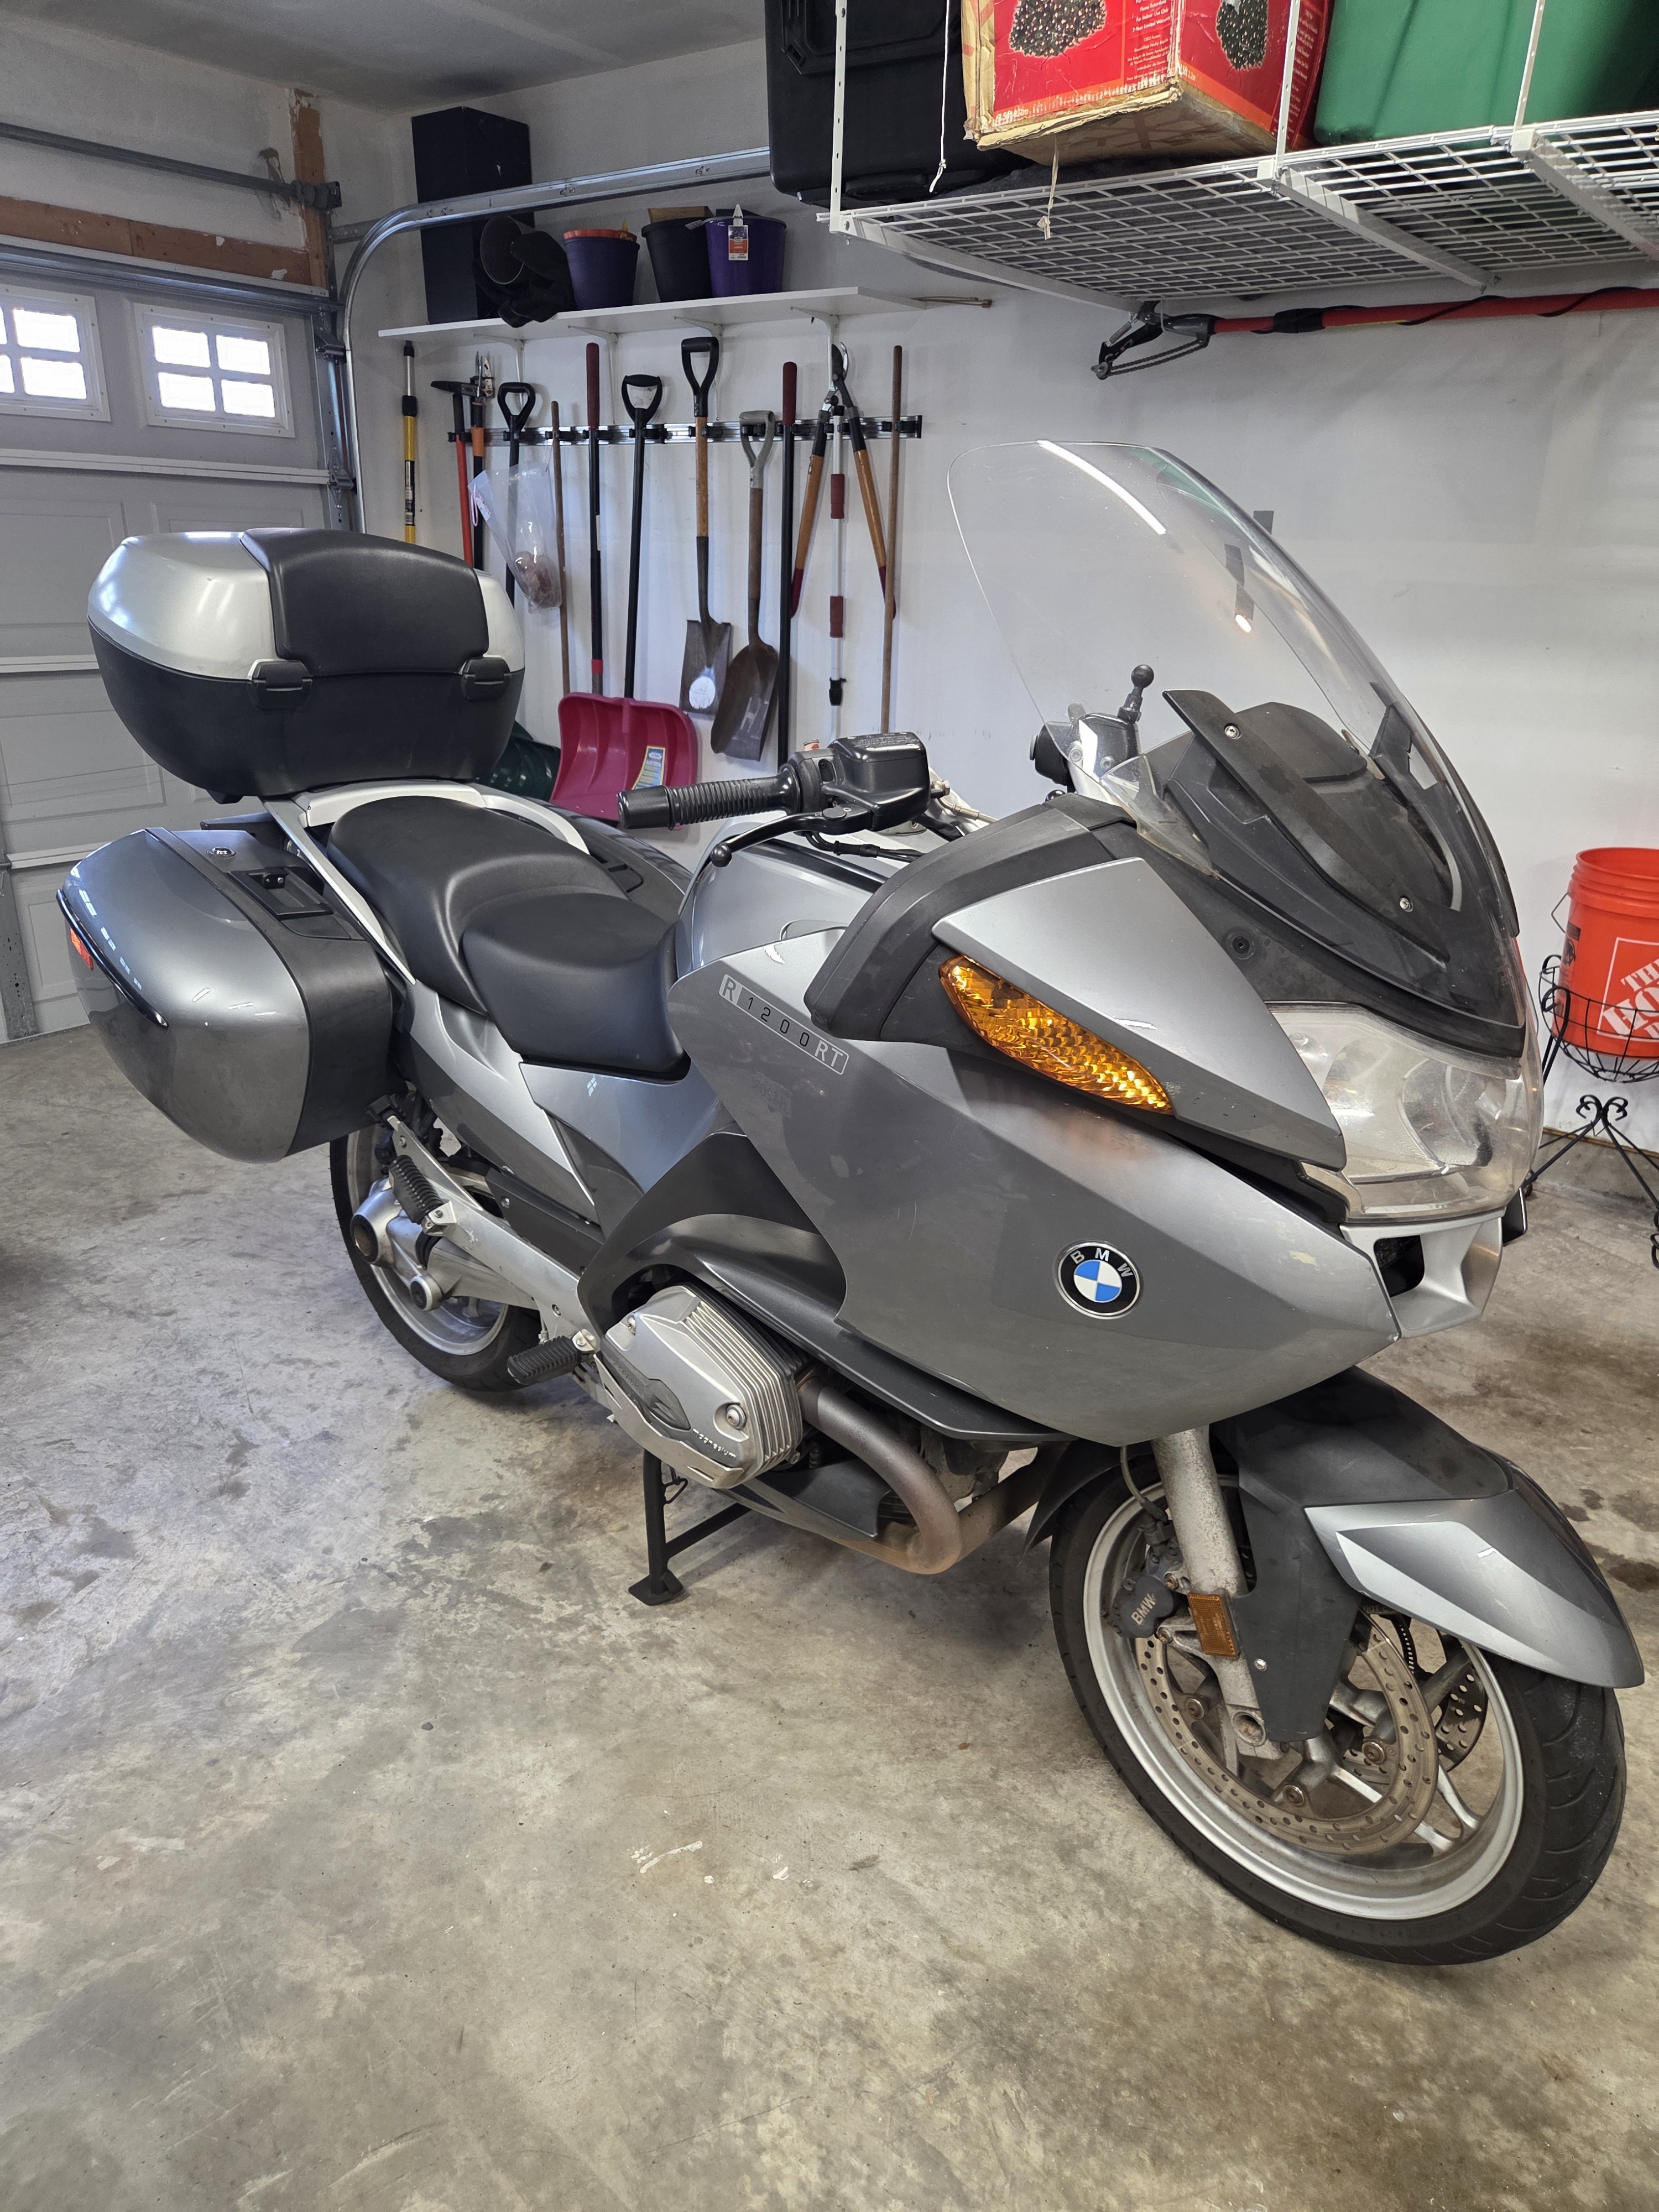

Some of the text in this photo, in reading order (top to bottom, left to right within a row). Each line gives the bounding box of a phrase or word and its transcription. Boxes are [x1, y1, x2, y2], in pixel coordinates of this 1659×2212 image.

[722, 977, 843, 1067] R 1200 RT
[1070, 1248, 1133, 1278] BMW
[1131, 1593, 1156, 1626] BMW
